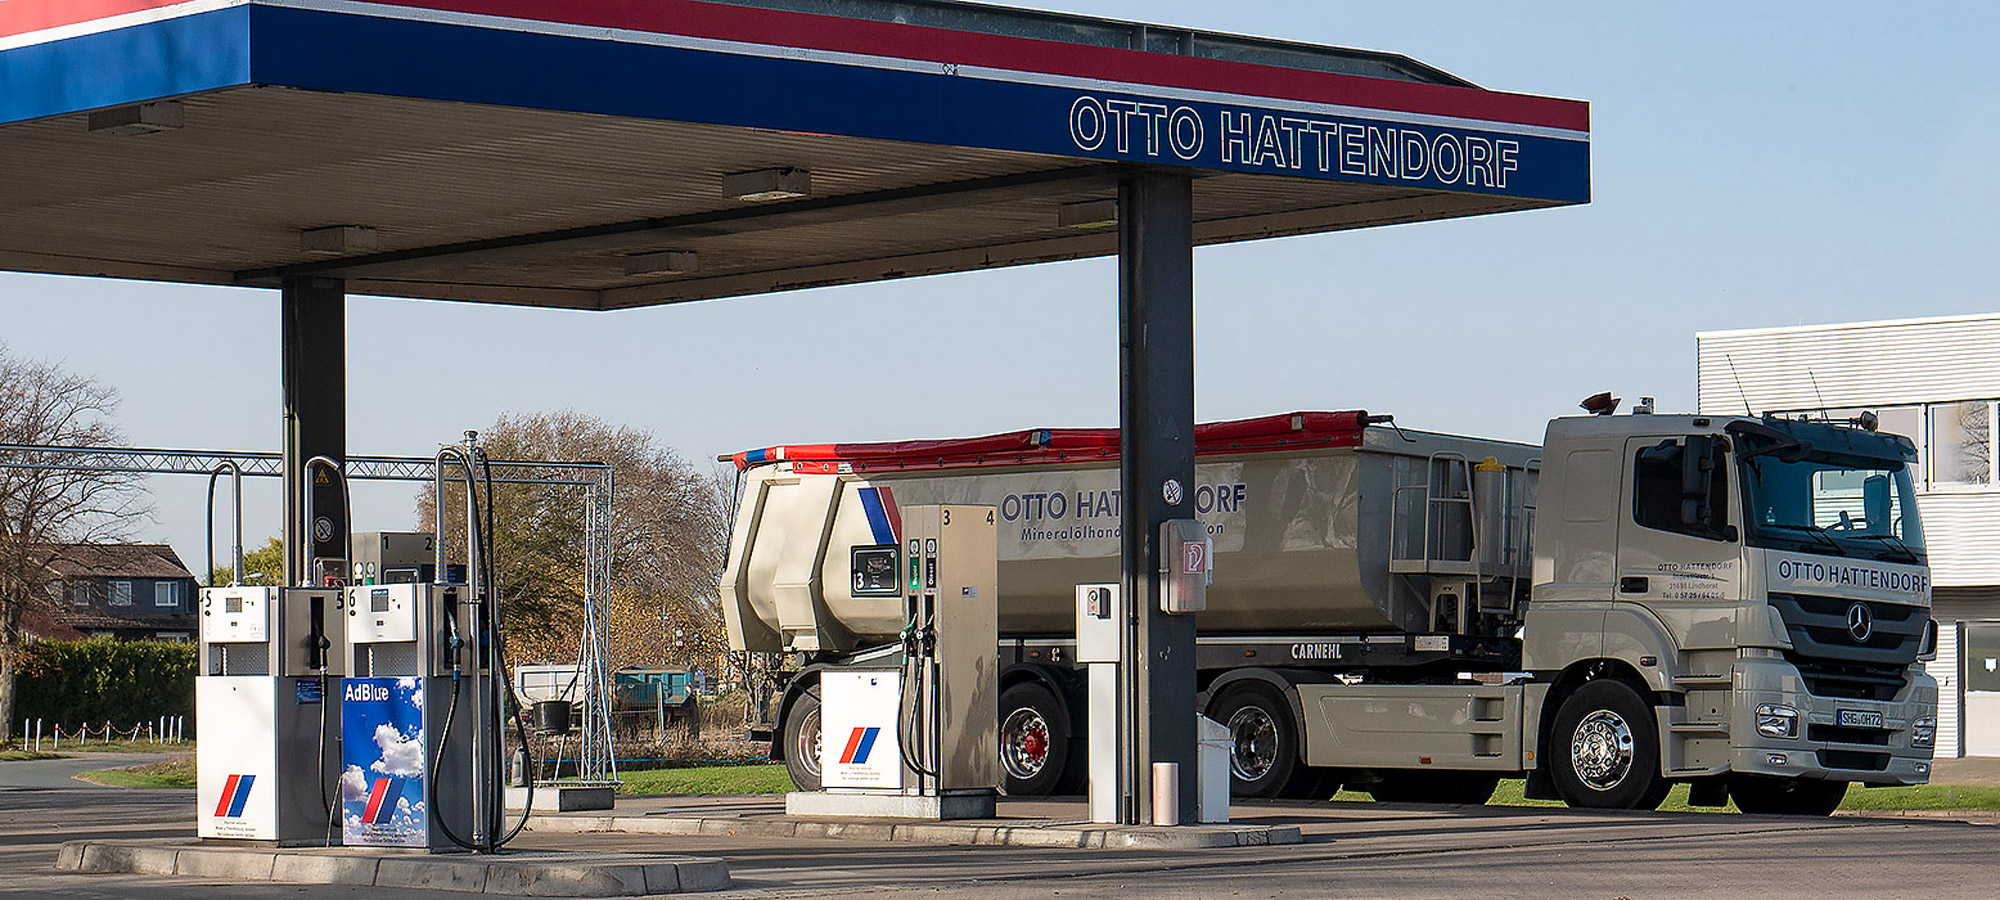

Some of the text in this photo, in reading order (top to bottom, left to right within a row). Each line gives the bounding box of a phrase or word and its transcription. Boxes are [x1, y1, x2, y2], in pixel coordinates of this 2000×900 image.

[1069, 95, 1520, 189] OTTO HATTENDORF
[1001, 484, 1246, 521] OTTO HATORF
[942, 509, 951, 526] 3
[986, 509, 996, 526] 4
[382, 535, 391, 550] 1
[425, 536, 434, 551] 2
[1658, 562, 1733, 572] OTTO HATTENDORF
[857, 572, 865, 588] 3
[1779, 560, 1927, 593] OTTO HATTENDORF
[205, 589, 212, 608] 5
[349, 588, 356, 608] 6
[1291, 643, 1342, 659] CARNEHL
[344, 683, 389, 702] AdBlue
